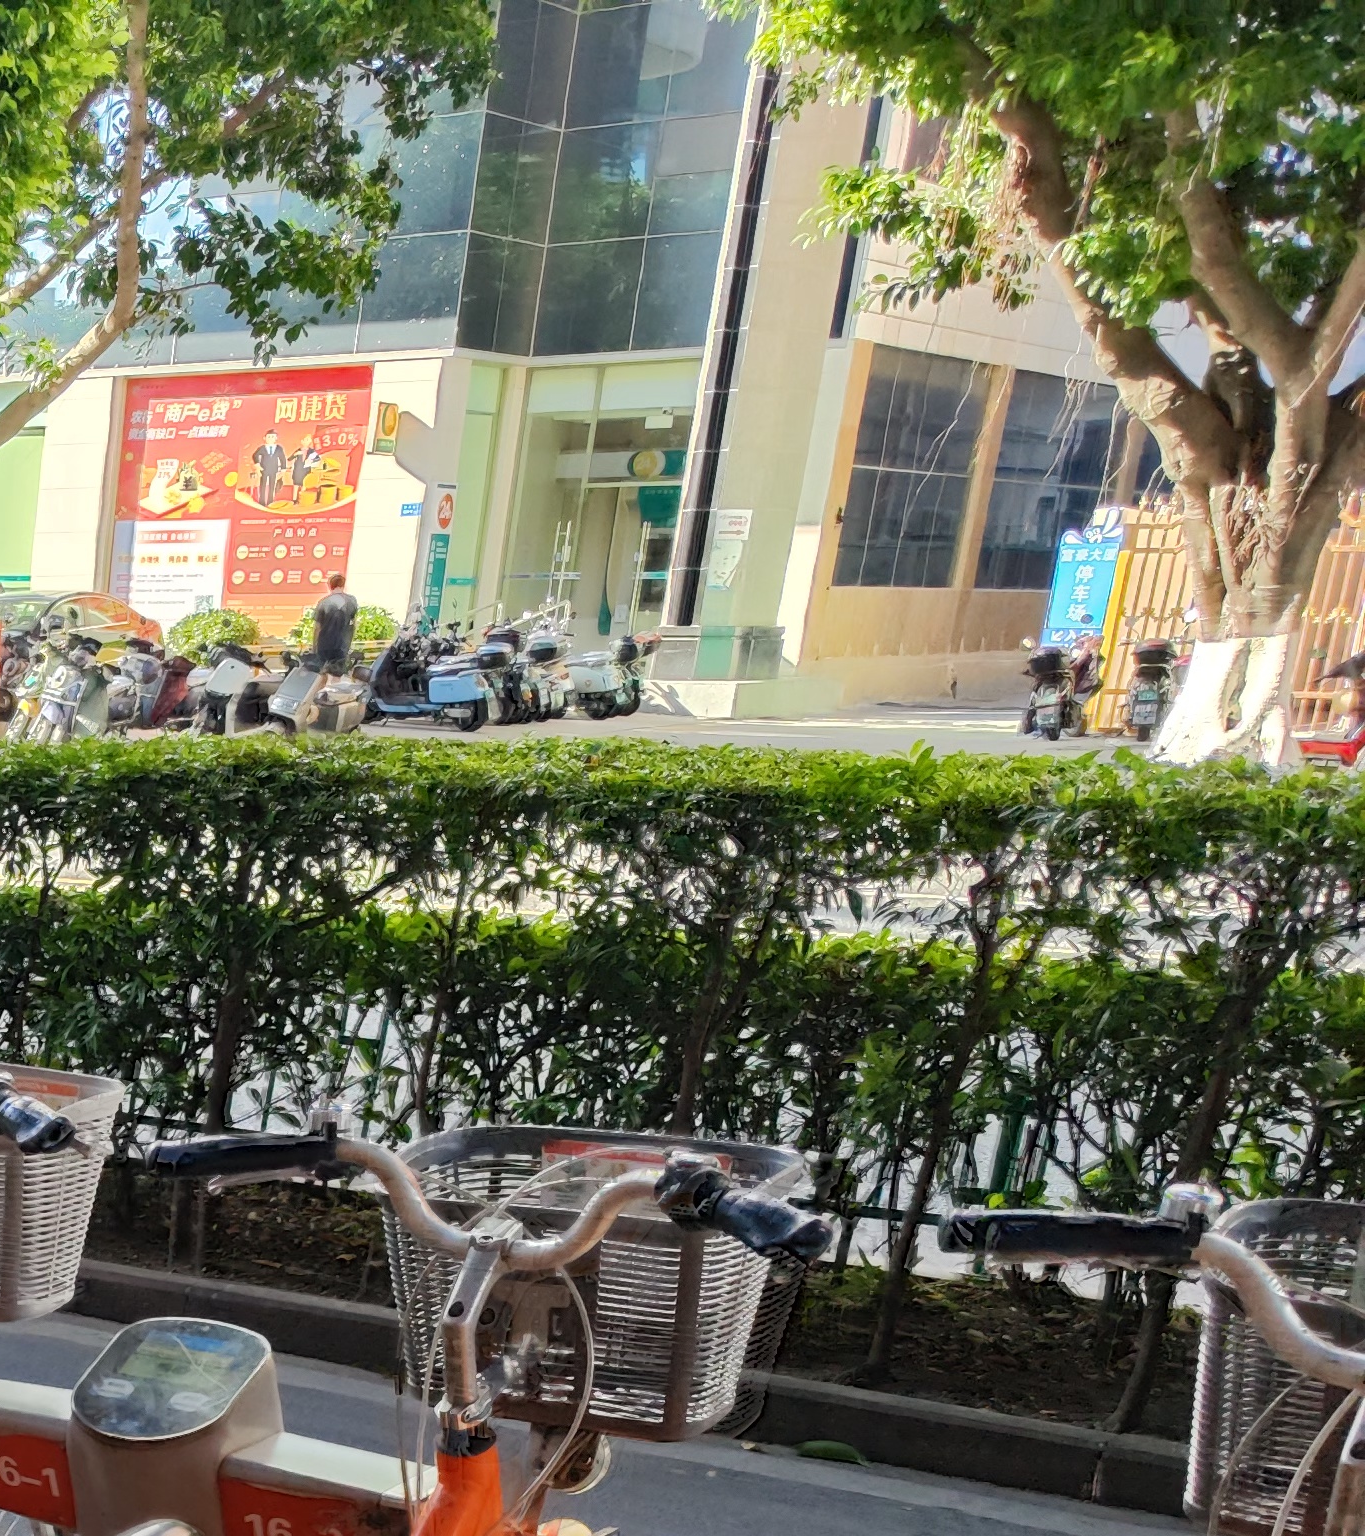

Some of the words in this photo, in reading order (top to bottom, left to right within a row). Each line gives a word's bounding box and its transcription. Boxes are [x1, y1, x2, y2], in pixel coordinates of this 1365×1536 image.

[274, 391, 348, 424] 网捷贷
[1065, 564, 1095, 622] 停车场
